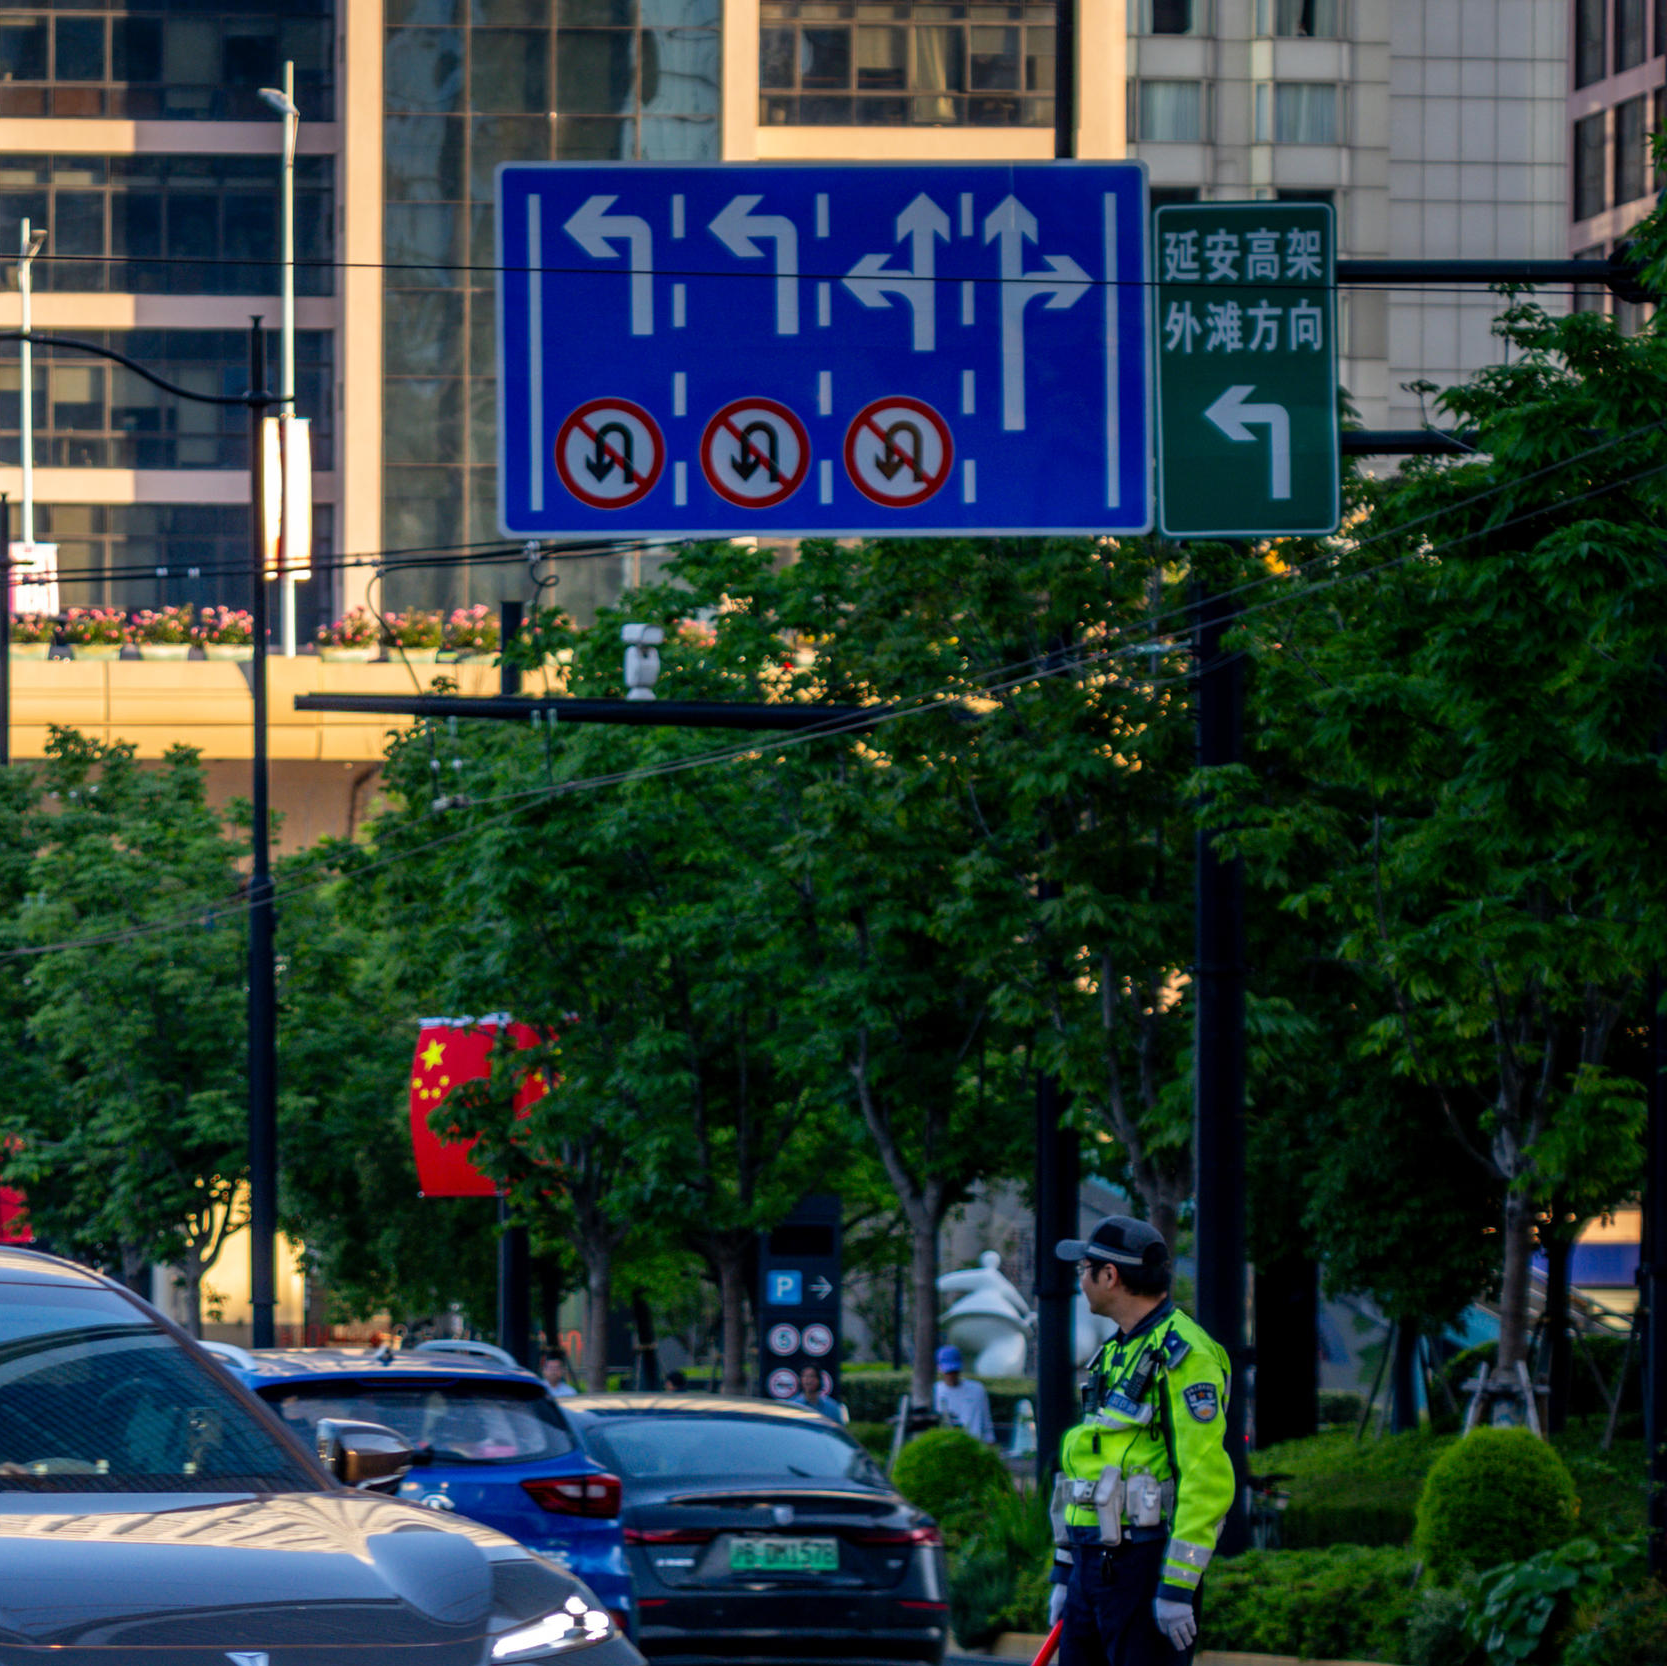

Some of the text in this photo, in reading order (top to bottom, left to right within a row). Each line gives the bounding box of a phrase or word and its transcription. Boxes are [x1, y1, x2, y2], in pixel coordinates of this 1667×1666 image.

[1164, 228, 1323, 282] 延安高架
[1165, 299, 1324, 353] 外滩方向
[777, 1276, 793, 1298] P
